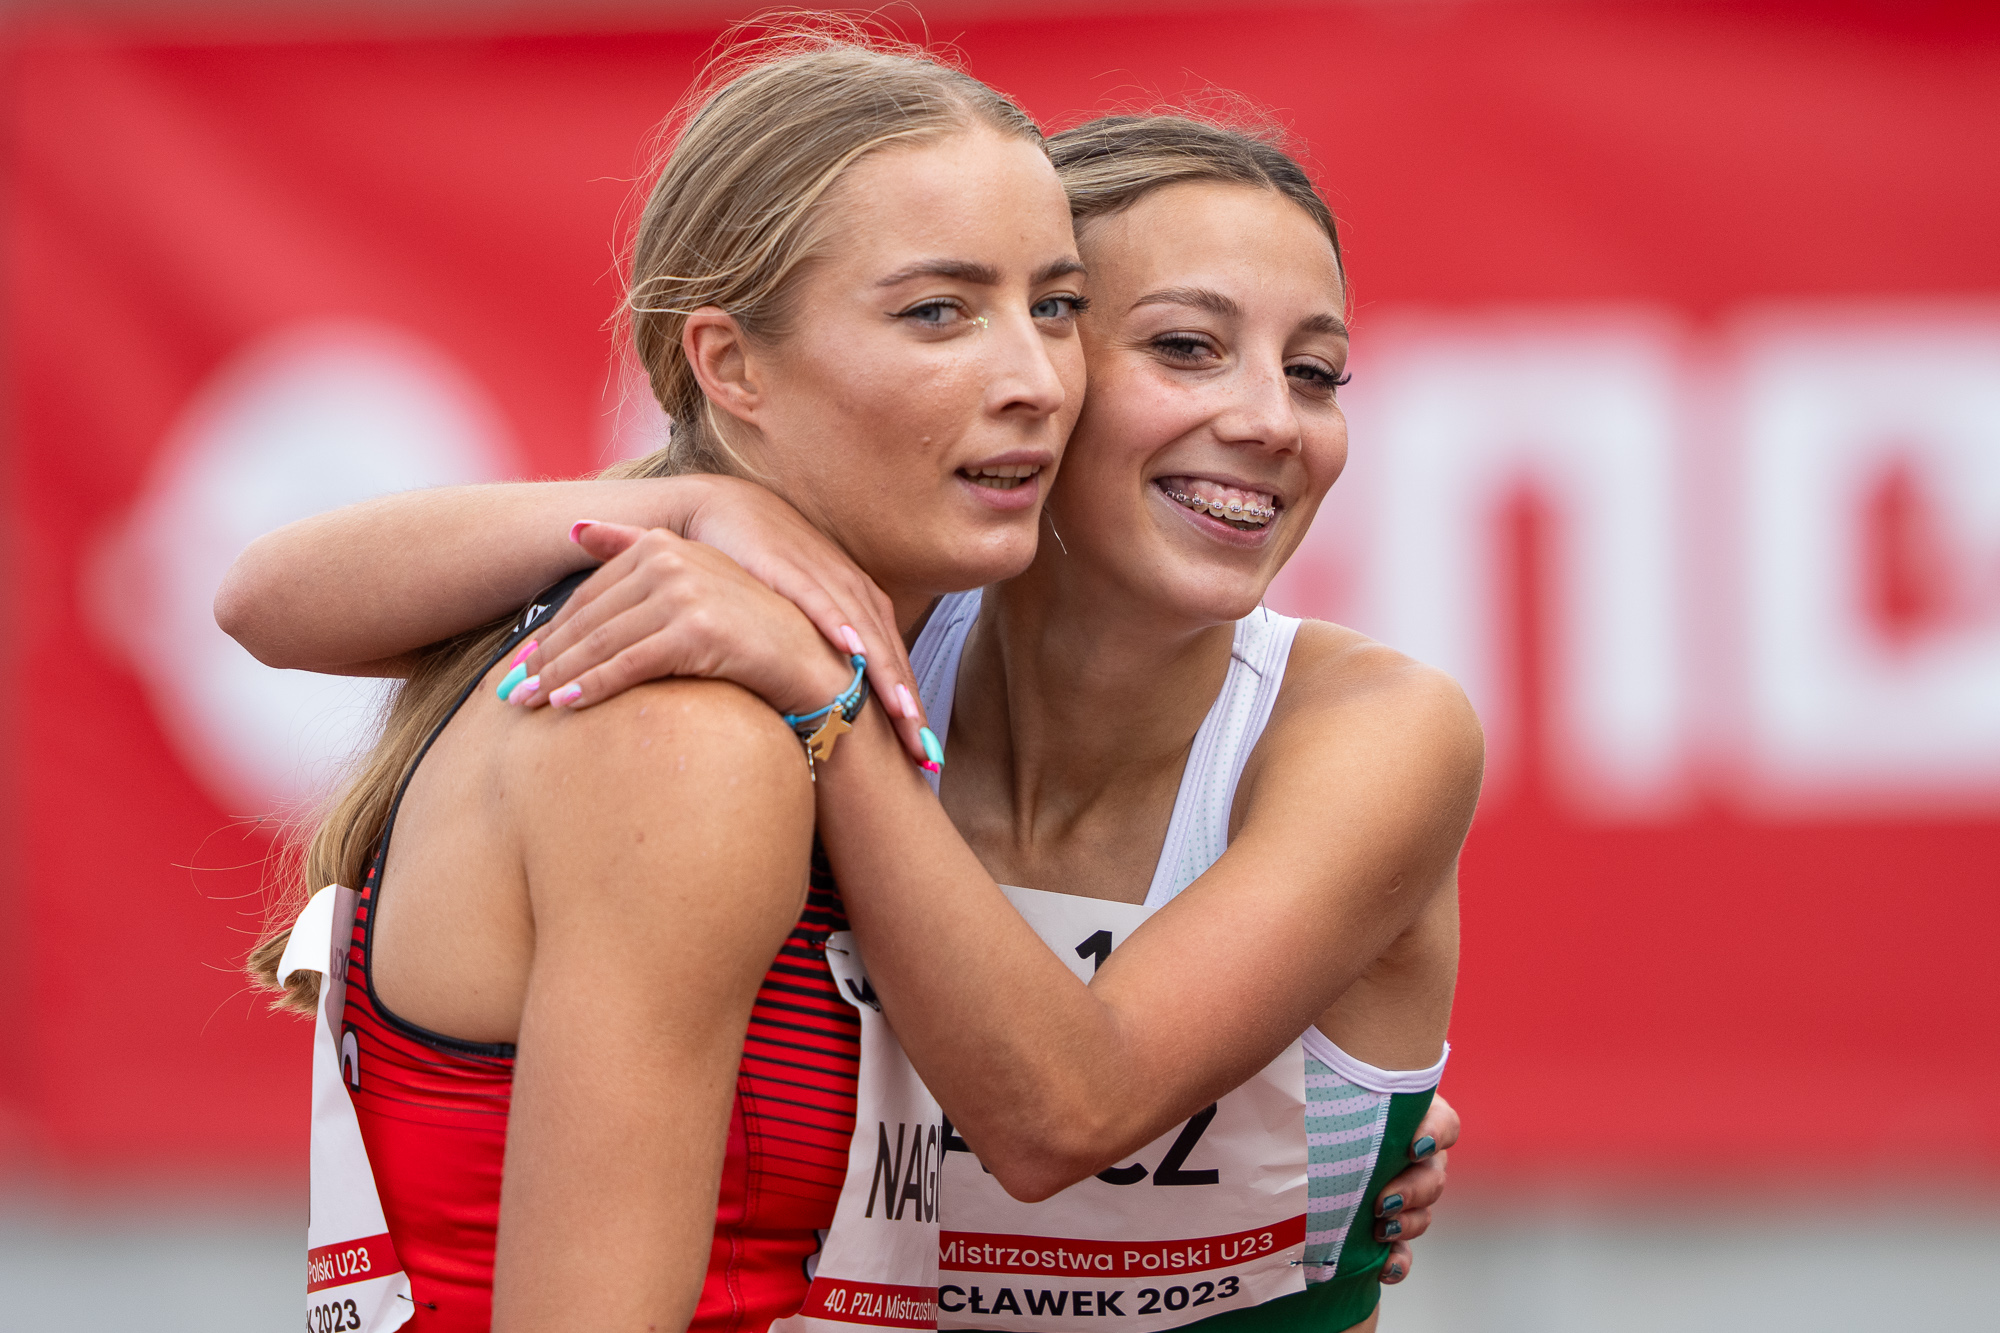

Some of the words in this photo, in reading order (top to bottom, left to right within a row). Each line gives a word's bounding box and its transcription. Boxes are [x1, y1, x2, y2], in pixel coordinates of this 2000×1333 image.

[308, 1253, 335, 1284] Polski
[335, 1247, 371, 1276] U23
[939, 1240, 1113, 1271] Mistrzostwa
[1124, 1244, 1211, 1271] Polski
[1221, 1232, 1274, 1261] U23
[823, 1288, 846, 1314] 40.
[849, 1292, 883, 1317] PZLA
[1137, 1276, 1240, 1315] 2023
[315, 1299, 361, 1333] 2023
